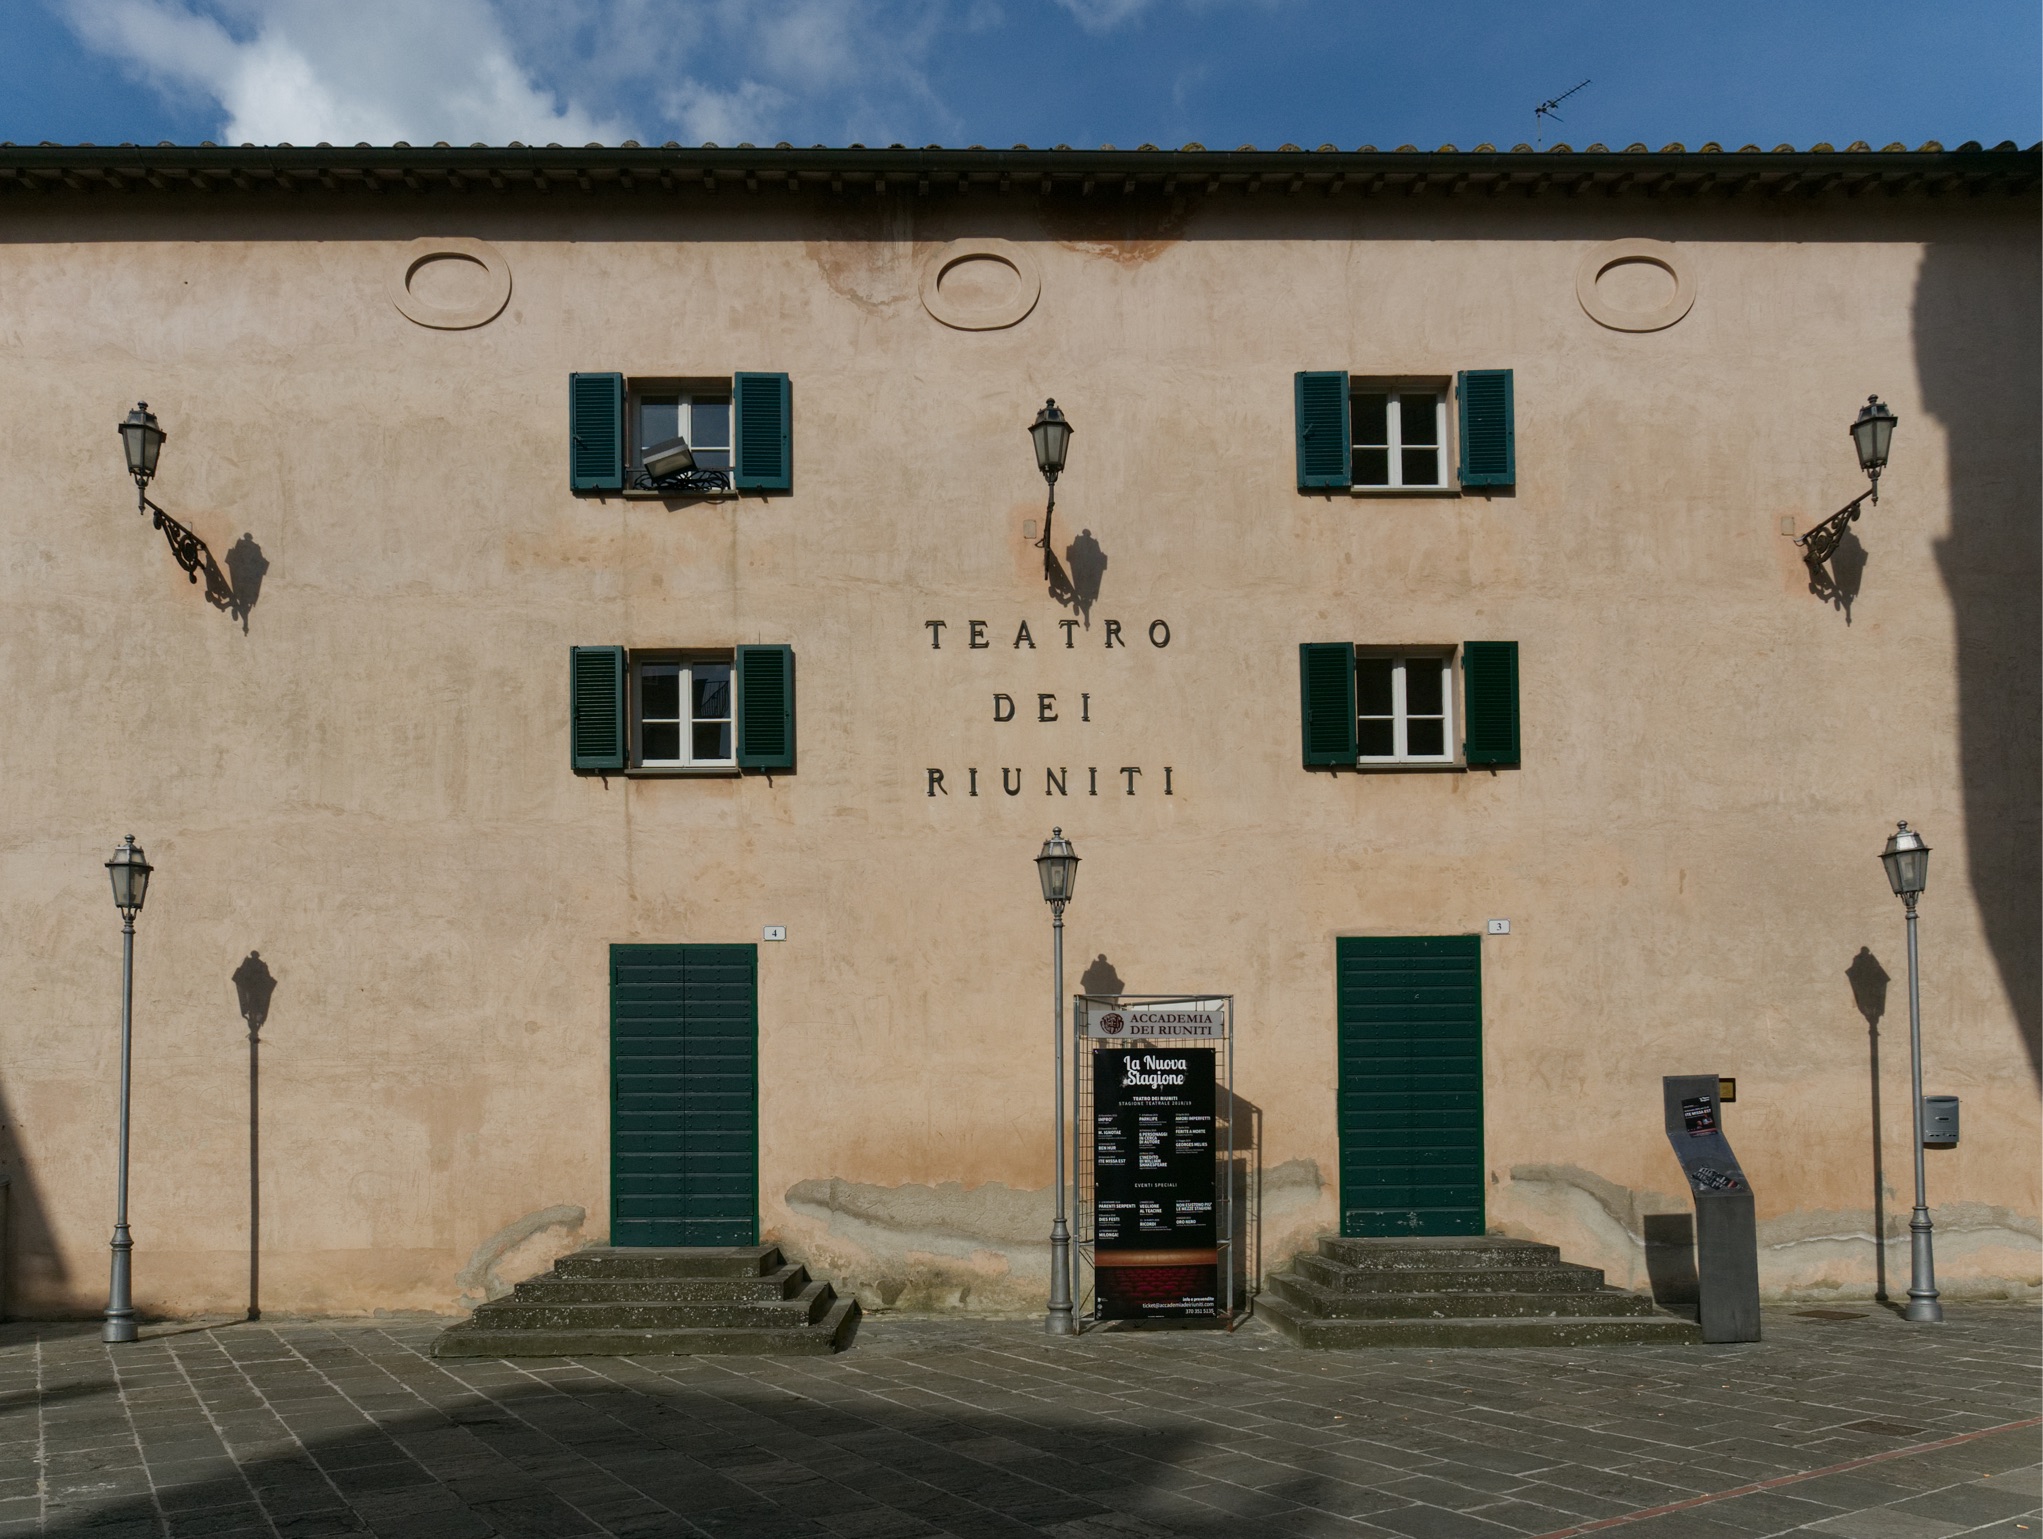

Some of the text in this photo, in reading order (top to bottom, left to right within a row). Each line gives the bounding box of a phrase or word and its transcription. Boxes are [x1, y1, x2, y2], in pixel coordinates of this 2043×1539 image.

[924, 619, 1171, 649] TEATRO
[992, 692, 1091, 722] DEI
[926, 766, 1174, 797] RIUNITI
[772, 929, 778, 937] 4
[1496, 922, 1502, 931] 3
[1130, 1014, 1213, 1024] ACCADEMIA
[1130, 1025, 1212, 1035] DEI RIUNITI
[1123, 1055, 1187, 1071] La Nuova
[1127, 1069, 1184, 1090] Stagione
